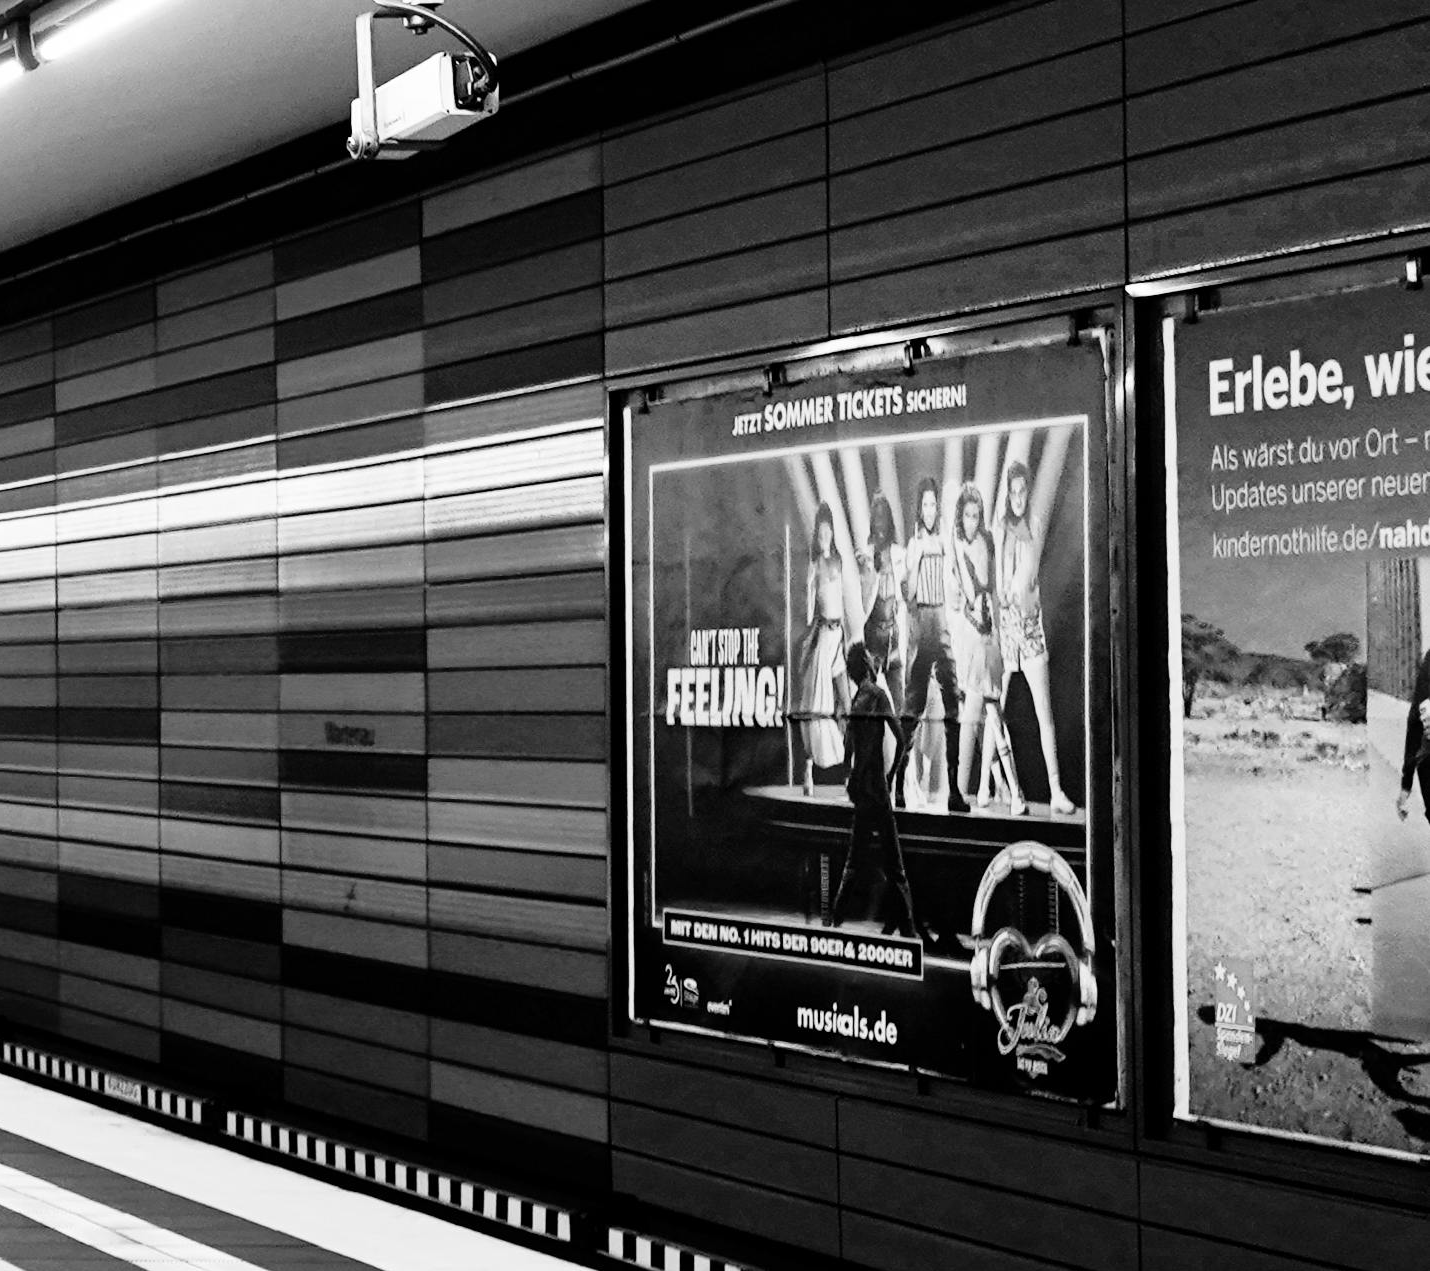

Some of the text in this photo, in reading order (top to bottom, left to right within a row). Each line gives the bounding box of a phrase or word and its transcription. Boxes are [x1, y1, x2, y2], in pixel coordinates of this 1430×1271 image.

[1209, 349, 1354, 416] Erlebe,
[732, 384, 967, 436] JETZT SOMMER TICKETS SICHERN!
[1211, 445, 1239, 472] Als
[1242, 440, 1294, 468] wärst
[1299, 436, 1324, 464] du
[1328, 437, 1360, 460] vor
[1365, 427, 1399, 458] Ort
[1211, 481, 1287, 514] Updates
[1291, 478, 1366, 504] unserer
[690, 628, 760, 666] CAN'T STOP THE
[666, 666, 784, 728] FEELING!
[670, 919, 693, 938] MIT
[694, 922, 718, 940] DEN
[719, 924, 741, 944] NO.
[743, 928, 749, 945] 1
[750, 928, 781, 949] HITS
[782, 934, 808, 953] DER
[844, 941, 855, 959] &
[858, 943, 913, 968] 2000ER
[797, 1002, 898, 1045] musicals.de
[1216, 1002, 1237, 1023] DZI
